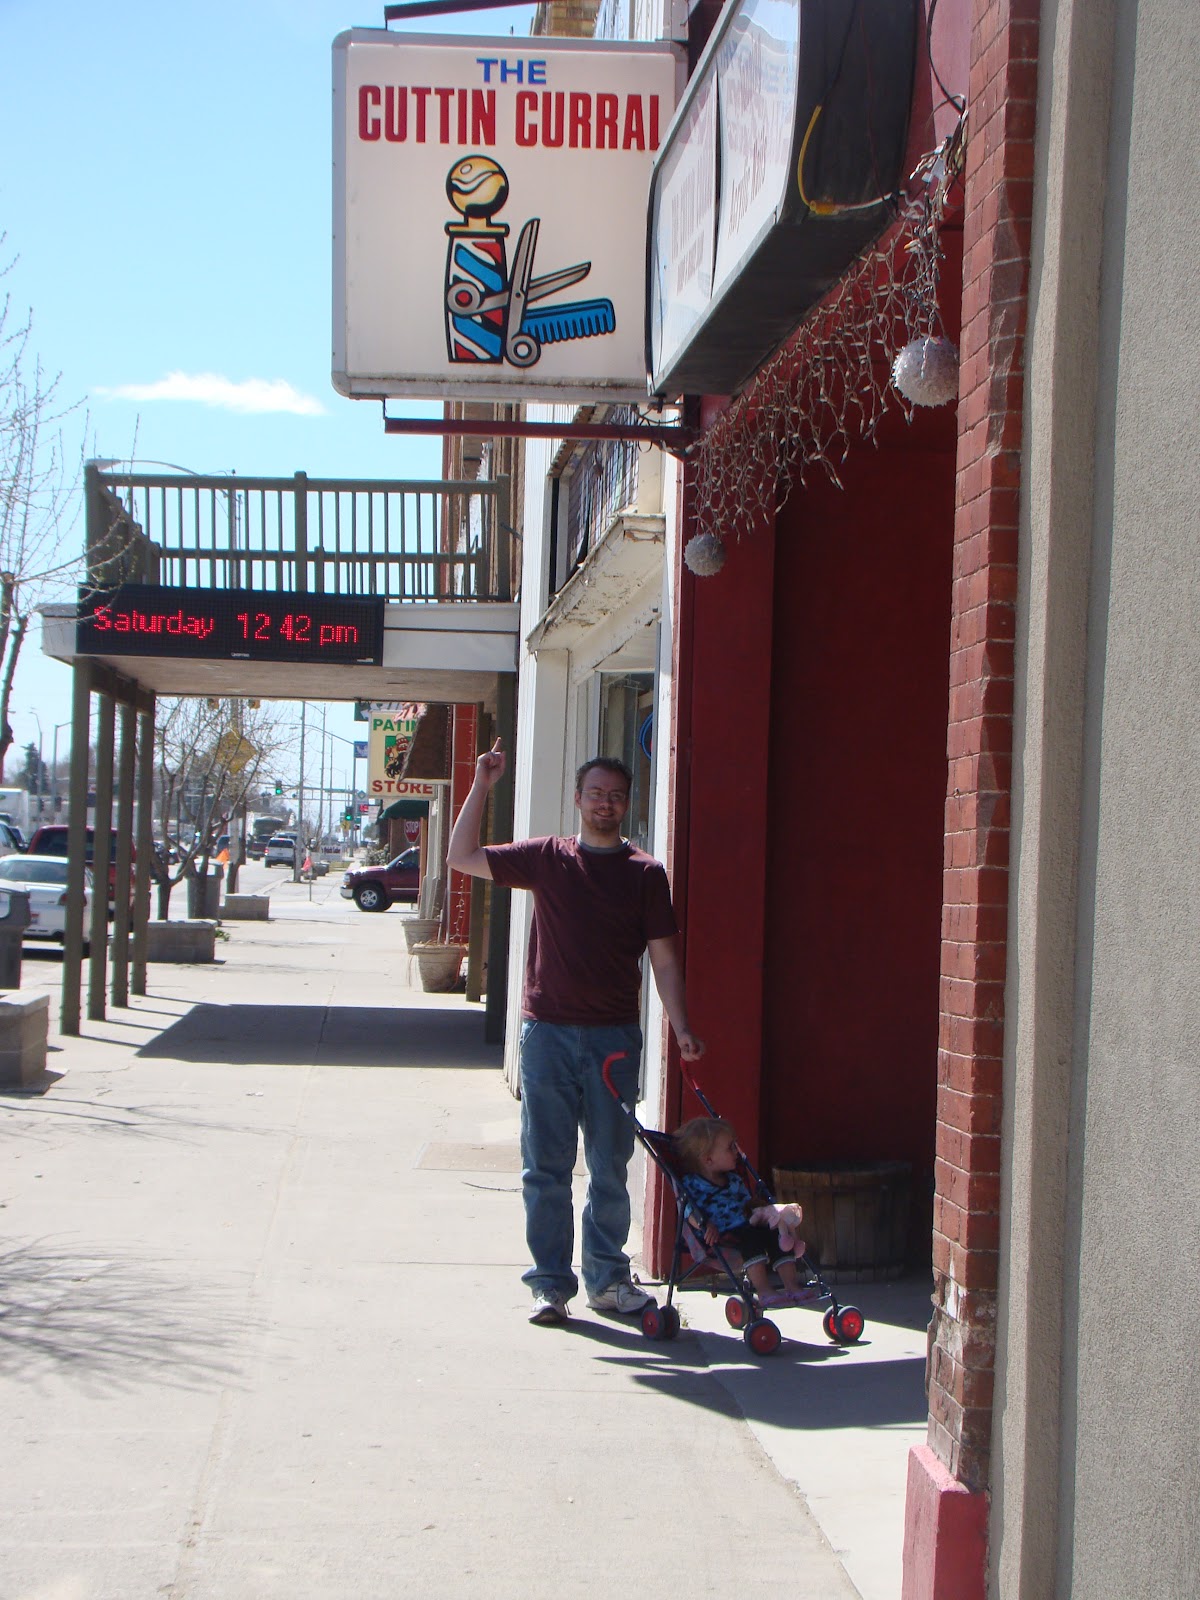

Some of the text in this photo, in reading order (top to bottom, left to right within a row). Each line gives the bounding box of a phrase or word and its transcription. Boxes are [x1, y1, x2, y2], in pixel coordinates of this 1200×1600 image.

[476, 58, 547, 85] THE
[358, 85, 660, 152] CUTTIN CURRAL
[93, 606, 359, 647] Saturday 12 42 pm
[371, 779, 433, 795] STORE
[405, 820, 420, 834] STOP
